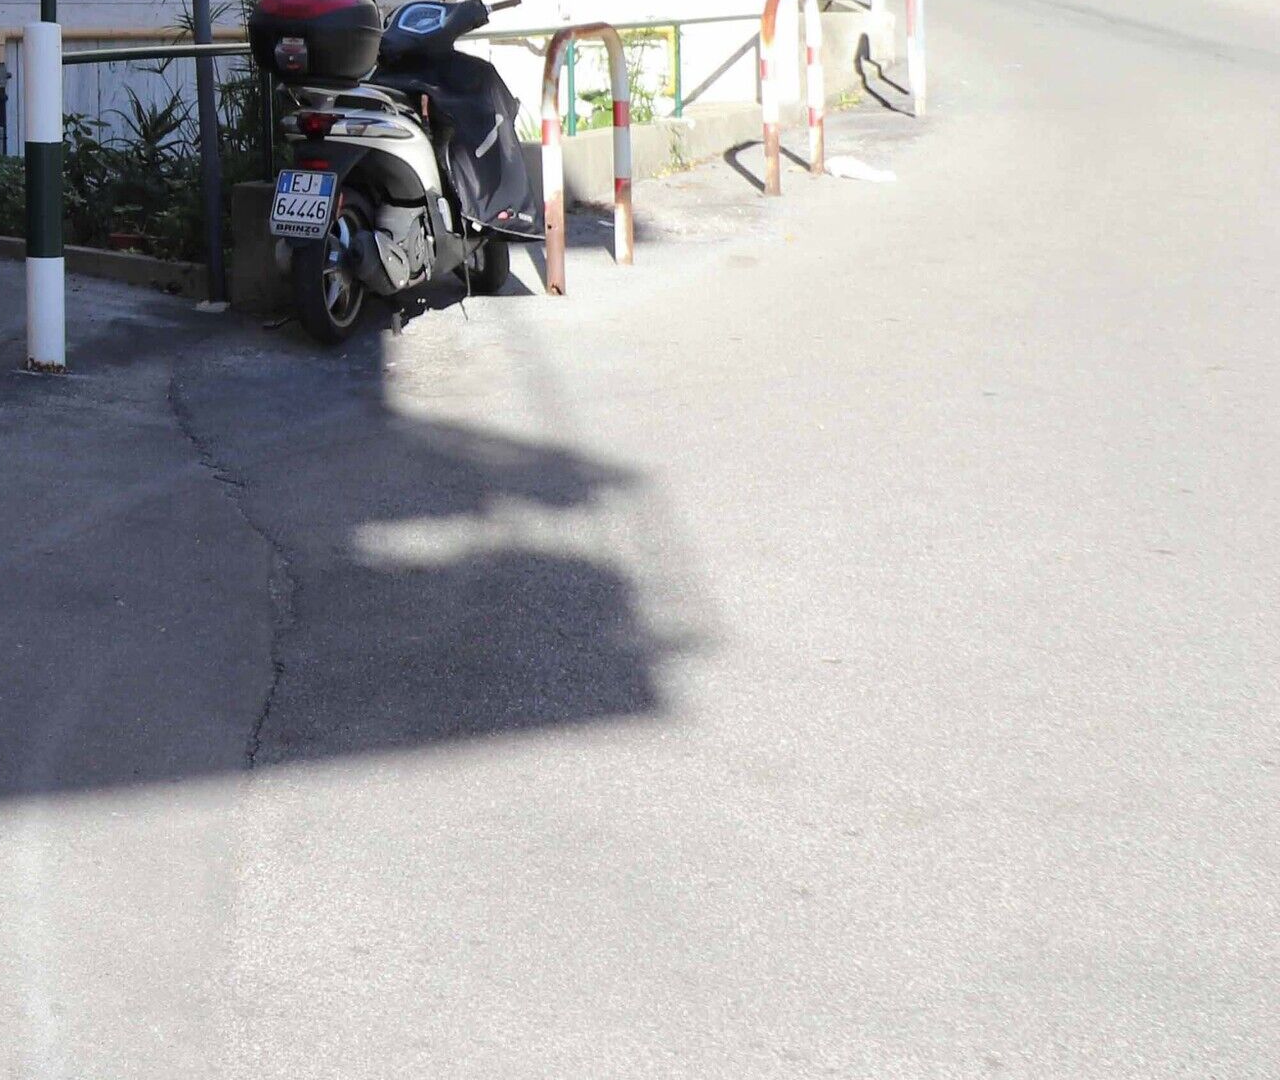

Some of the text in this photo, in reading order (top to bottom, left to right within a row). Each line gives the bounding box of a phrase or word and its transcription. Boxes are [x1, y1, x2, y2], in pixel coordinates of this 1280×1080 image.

[291, 174, 313, 193] EJ
[276, 197, 327, 220] 64446
[276, 223, 320, 234] BRINZO
